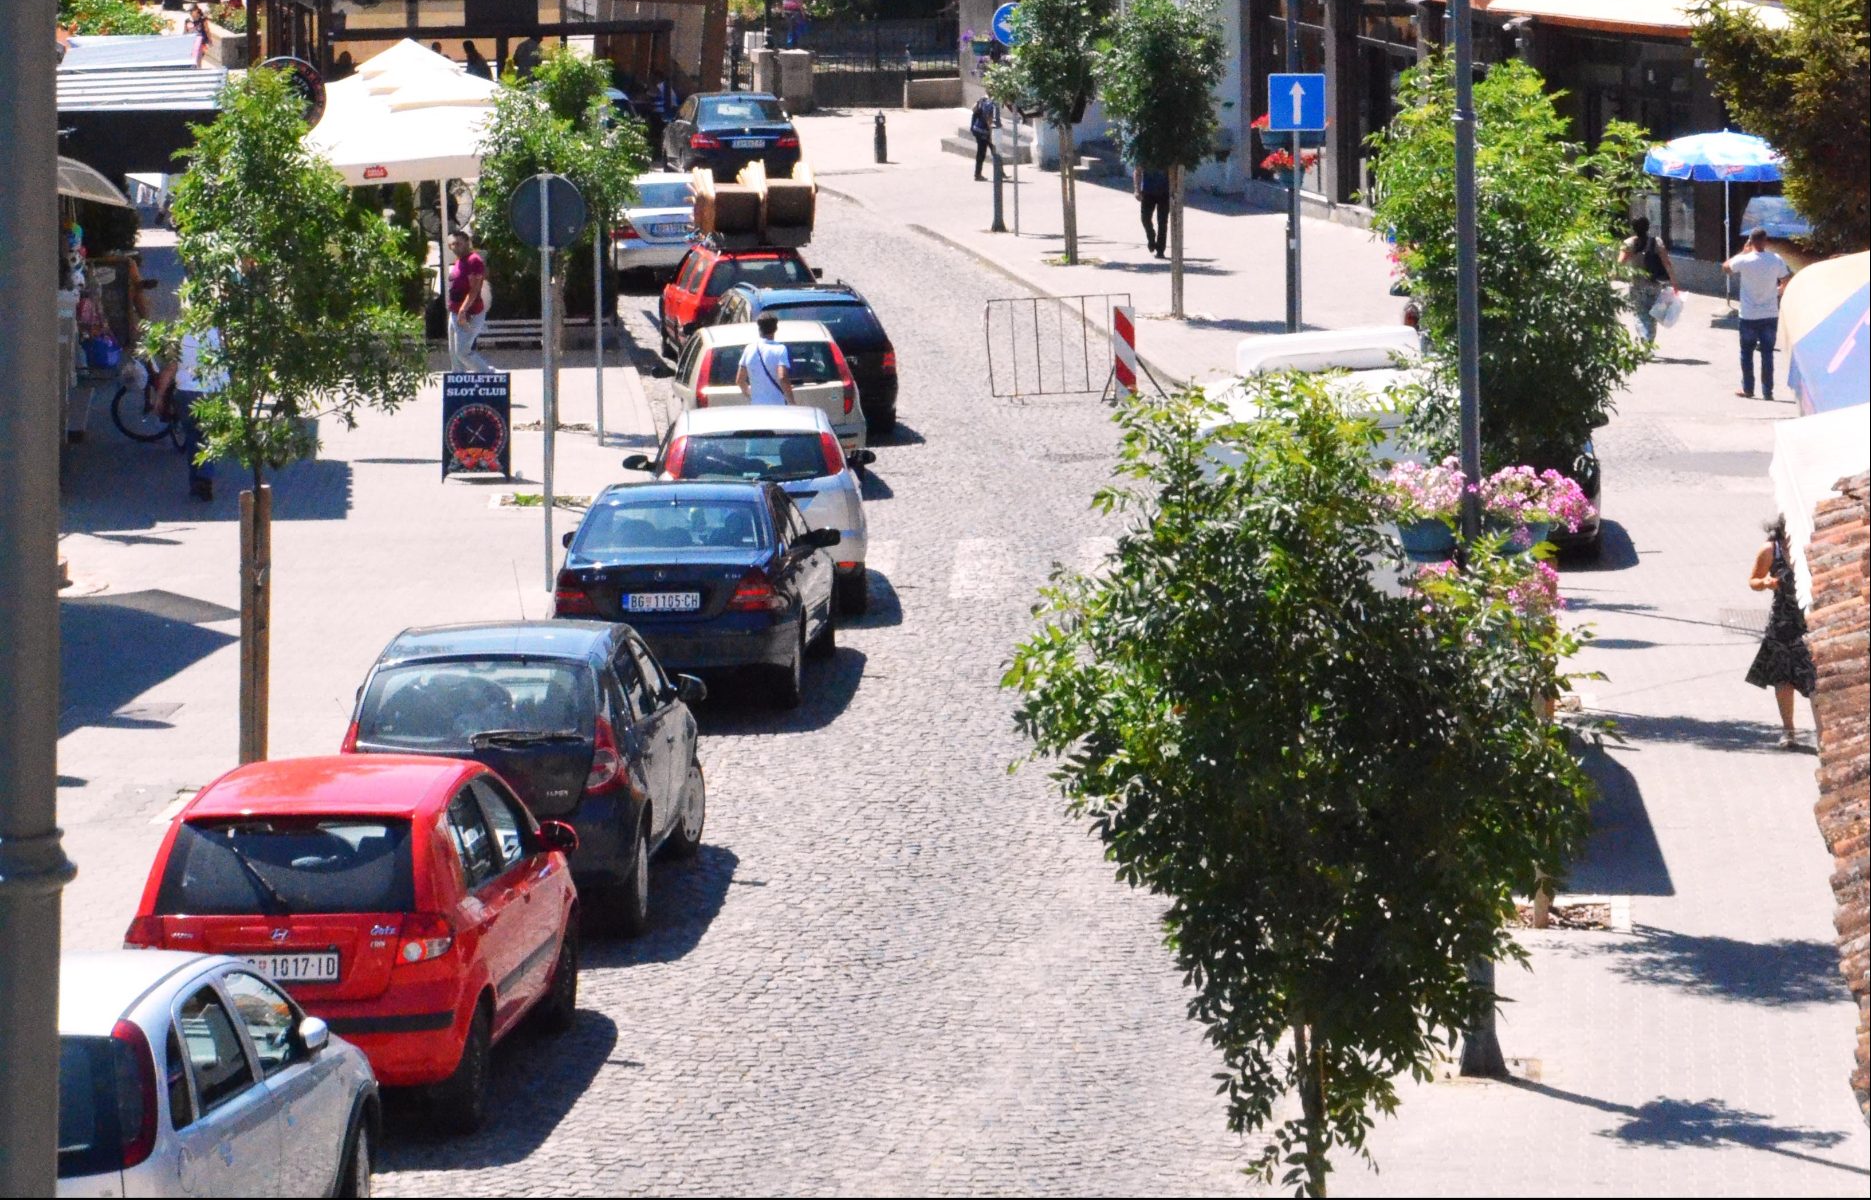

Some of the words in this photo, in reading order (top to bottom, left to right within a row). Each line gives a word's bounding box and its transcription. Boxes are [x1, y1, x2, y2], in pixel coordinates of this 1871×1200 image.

[447, 374, 507, 383] ROULETTE
[446, 387, 475, 396] SLOT
[478, 387, 507, 396] CLUB
[631, 593, 645, 608] BG
